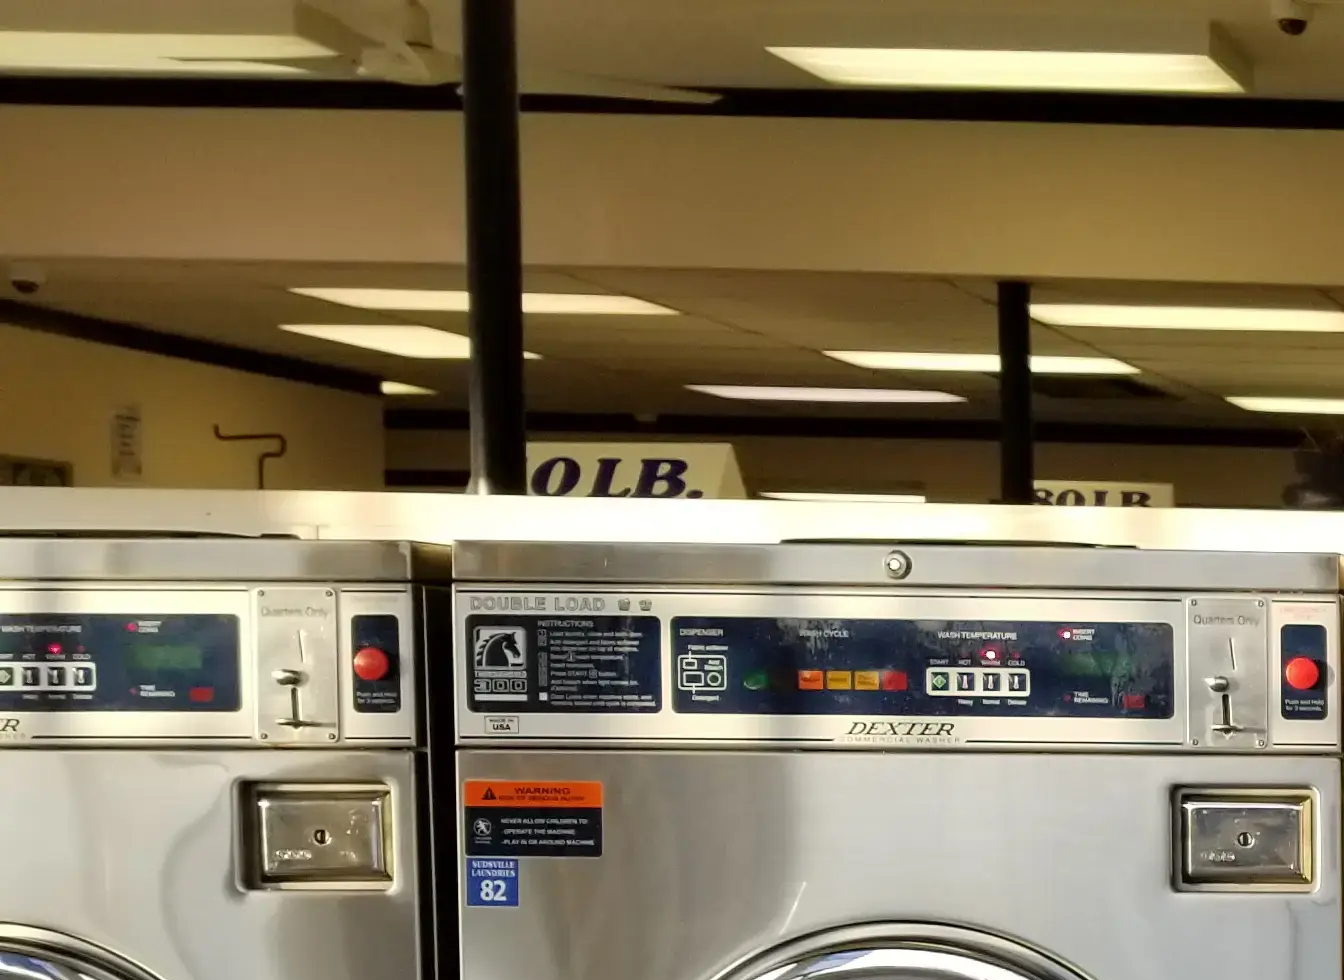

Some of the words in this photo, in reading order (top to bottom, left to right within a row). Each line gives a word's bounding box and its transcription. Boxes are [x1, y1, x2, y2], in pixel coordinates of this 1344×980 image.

[470, 596, 546, 611] DOUBLE
[554, 597, 605, 611] LOAD
[1193, 615, 1234, 625] Quarters
[1237, 616, 1260, 627] Only
[847, 723, 955, 735] DEXTER
[514, 787, 570, 795] WARNING
[480, 880, 507, 901] 82
